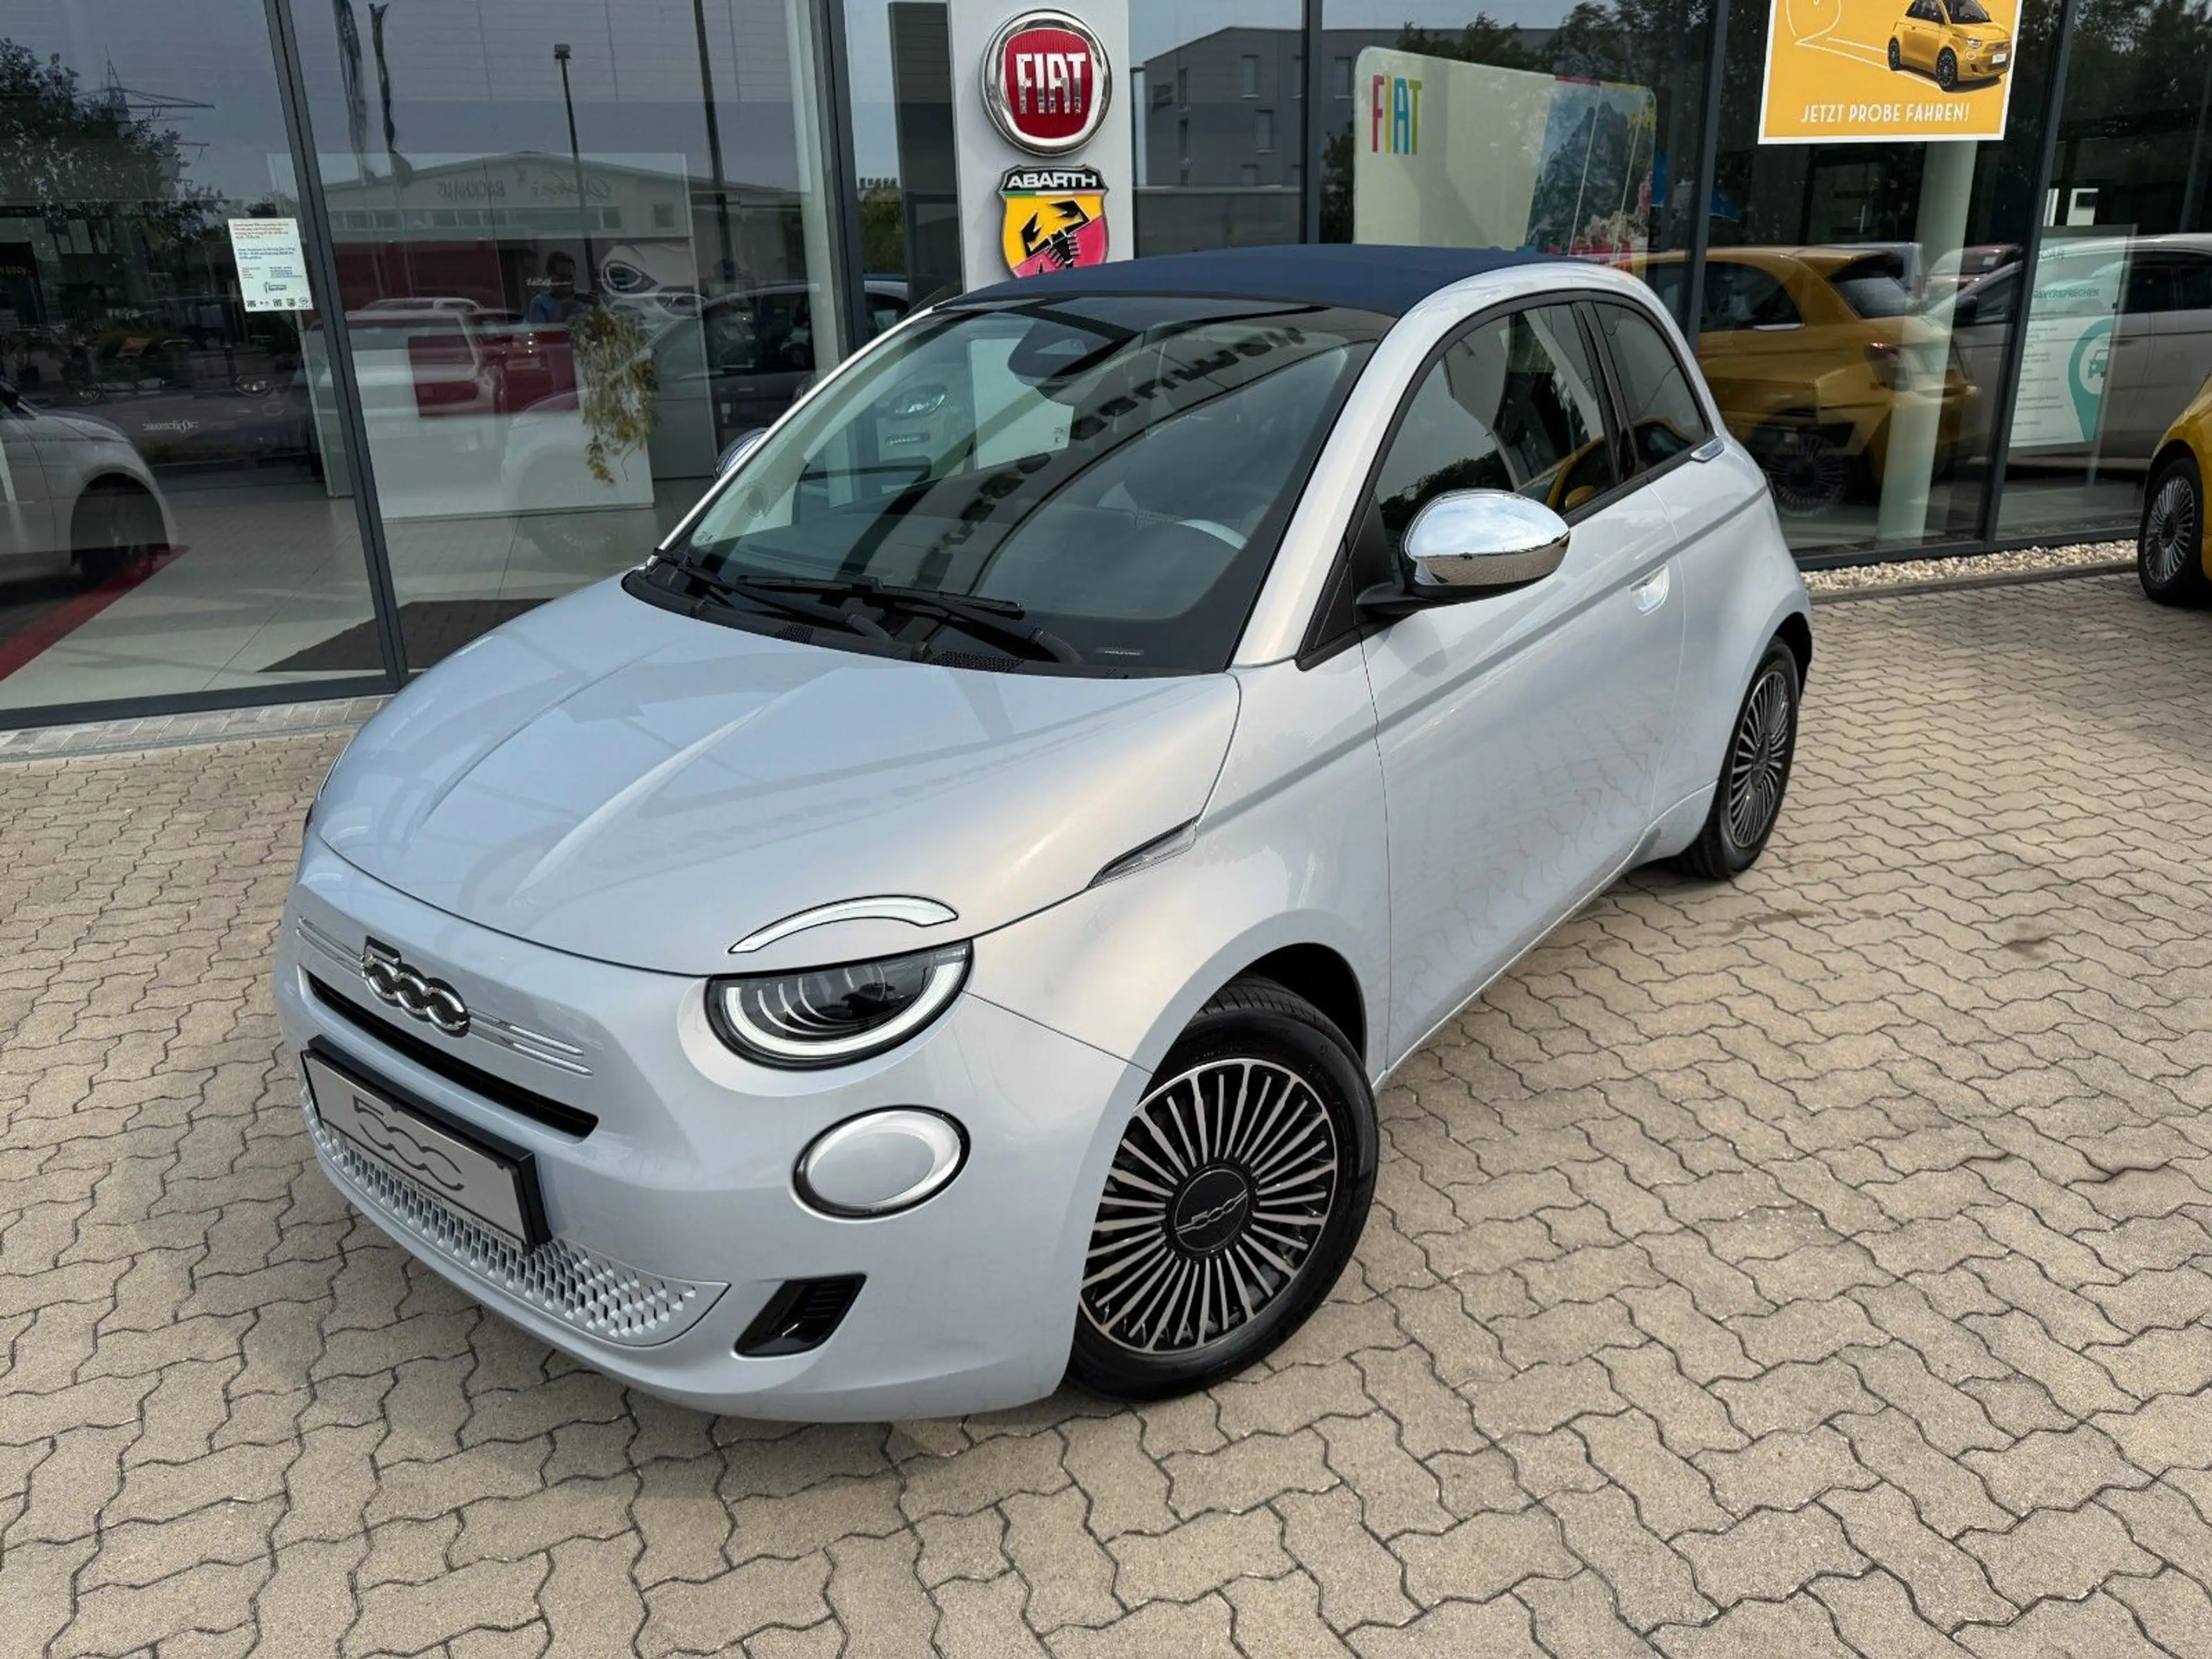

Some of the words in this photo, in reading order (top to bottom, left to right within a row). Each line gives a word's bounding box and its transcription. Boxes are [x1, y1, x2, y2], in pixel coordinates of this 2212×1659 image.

[1016, 52, 1086, 113] FIAT
[1372, 75, 1422, 155] FIAT
[1800, 104, 1845, 123] JETZT
[1848, 103, 1902, 123] PROBE
[1905, 103, 1970, 122] FAHREN!
[1007, 172, 1097, 189] ABARTH
[362, 935, 471, 1037] 500
[353, 1094, 465, 1192] 500
